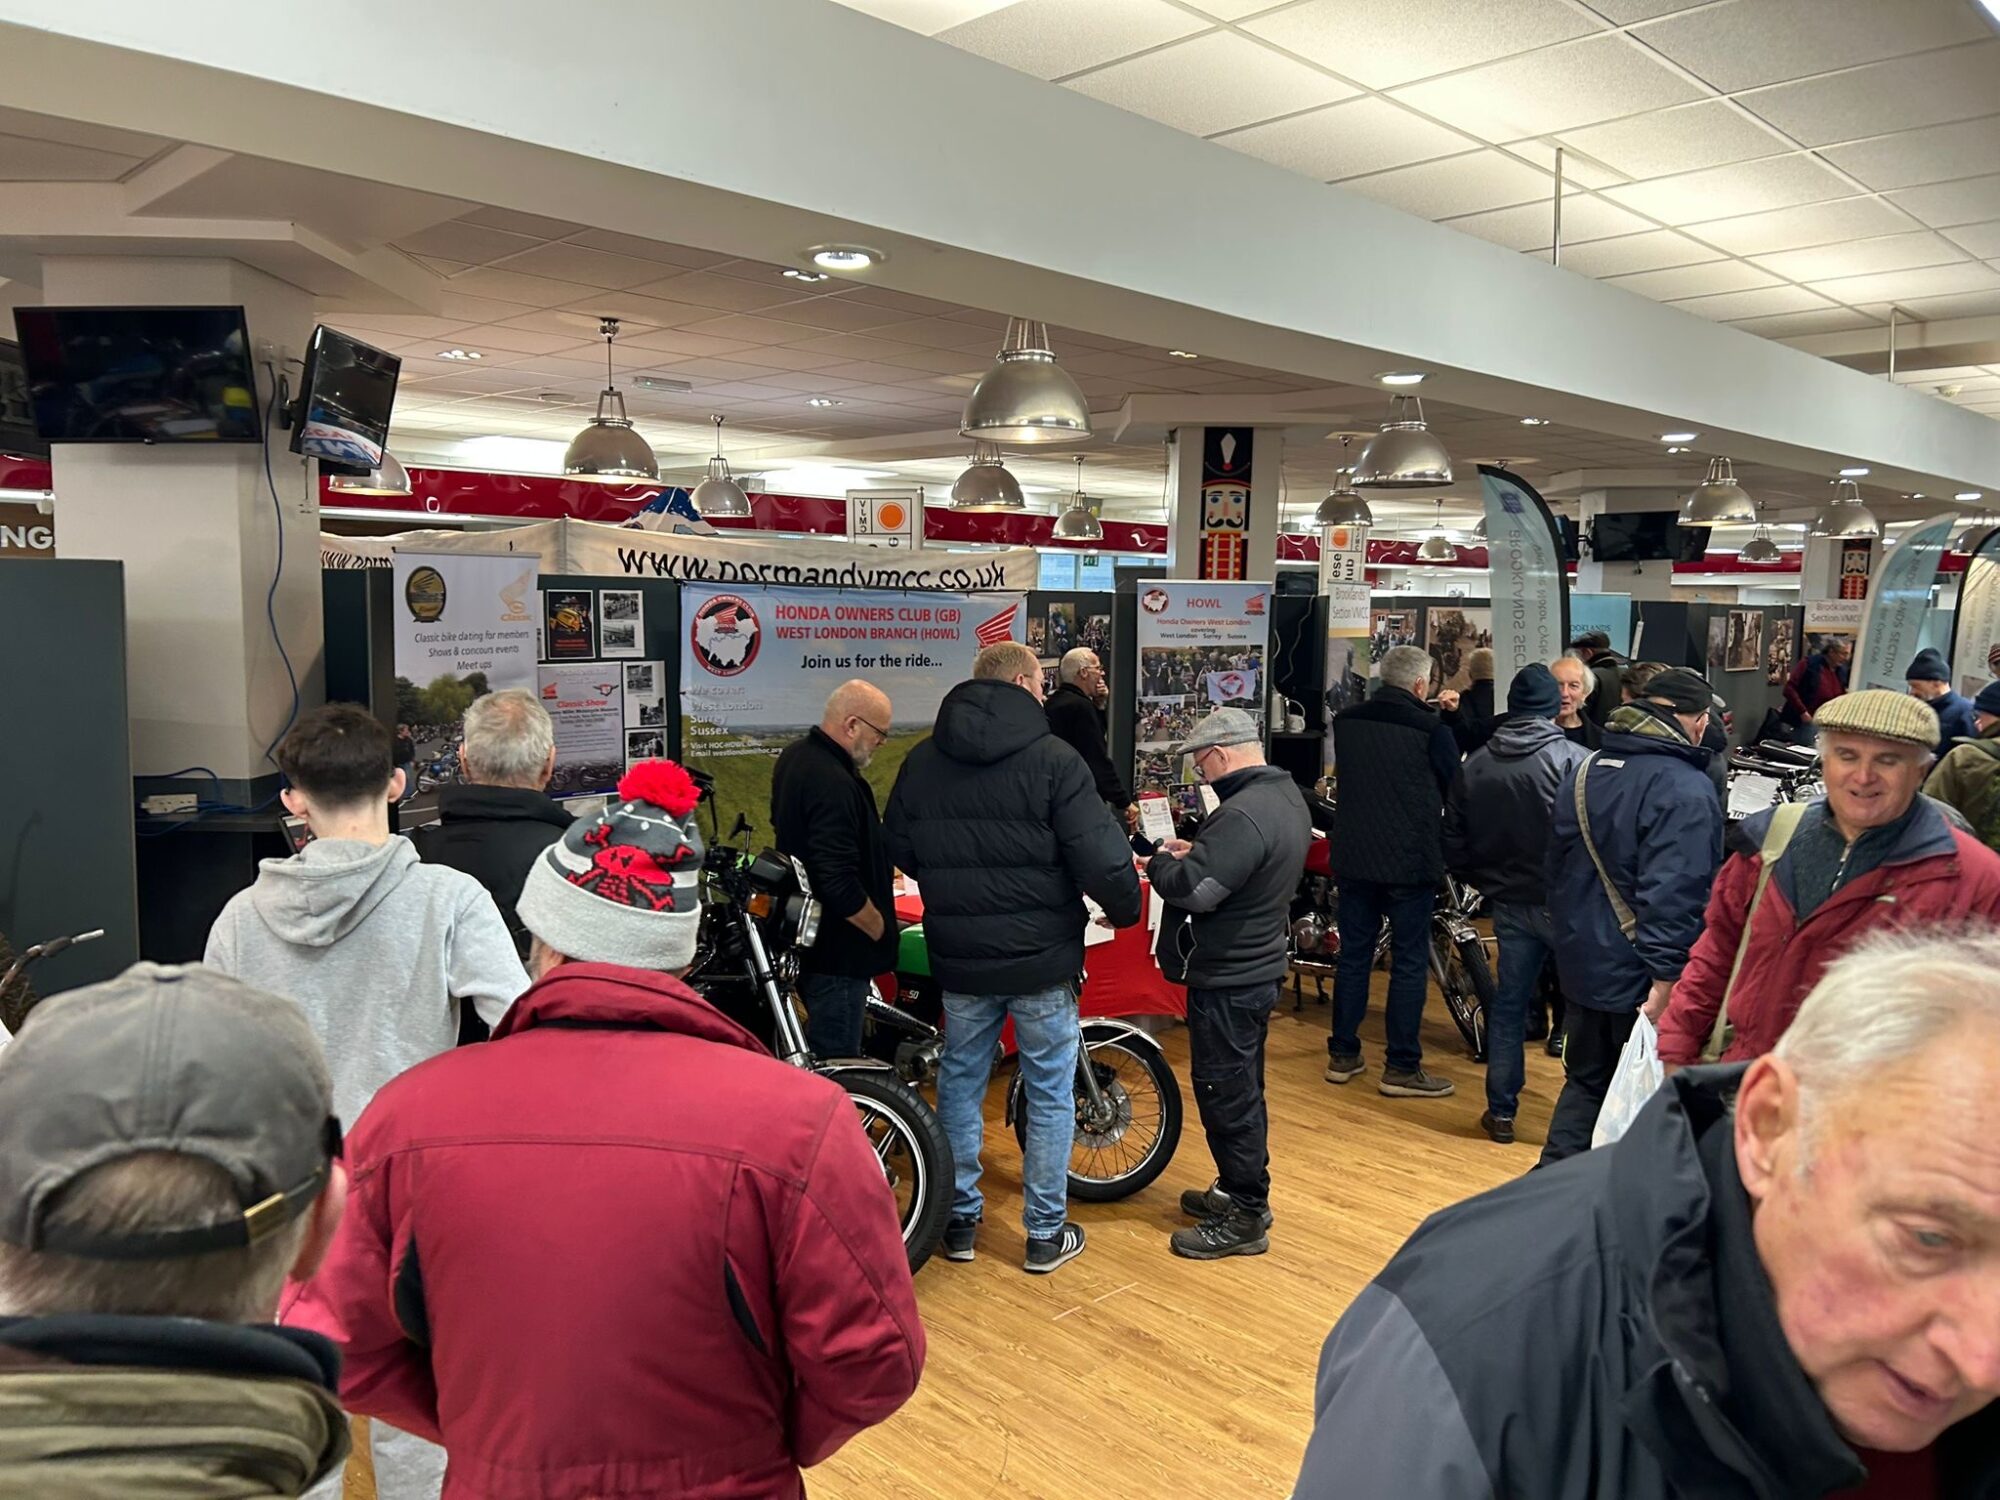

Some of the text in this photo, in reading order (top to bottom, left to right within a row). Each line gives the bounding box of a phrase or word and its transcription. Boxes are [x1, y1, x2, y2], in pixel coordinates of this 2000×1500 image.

[1344, 558, 1354, 580] lub
[1186, 598, 1222, 608] HOWL
[775, 605, 961, 624] HONDA OWNERS CLUB (GB)
[414, 630, 529, 643] Classic bike dating for members
[776, 626, 960, 641] WEST LONDON BRANCH (HOWL)
[428, 646, 519, 657] Shows & concours events
[457, 661, 493, 670] Meet ups
[801, 653, 943, 669] Join us for the ride...
[691, 701, 763, 711] West London
[690, 714, 727, 727] Surrey
[690, 726, 729, 736] Sussex
[690, 749, 711, 757] Email
